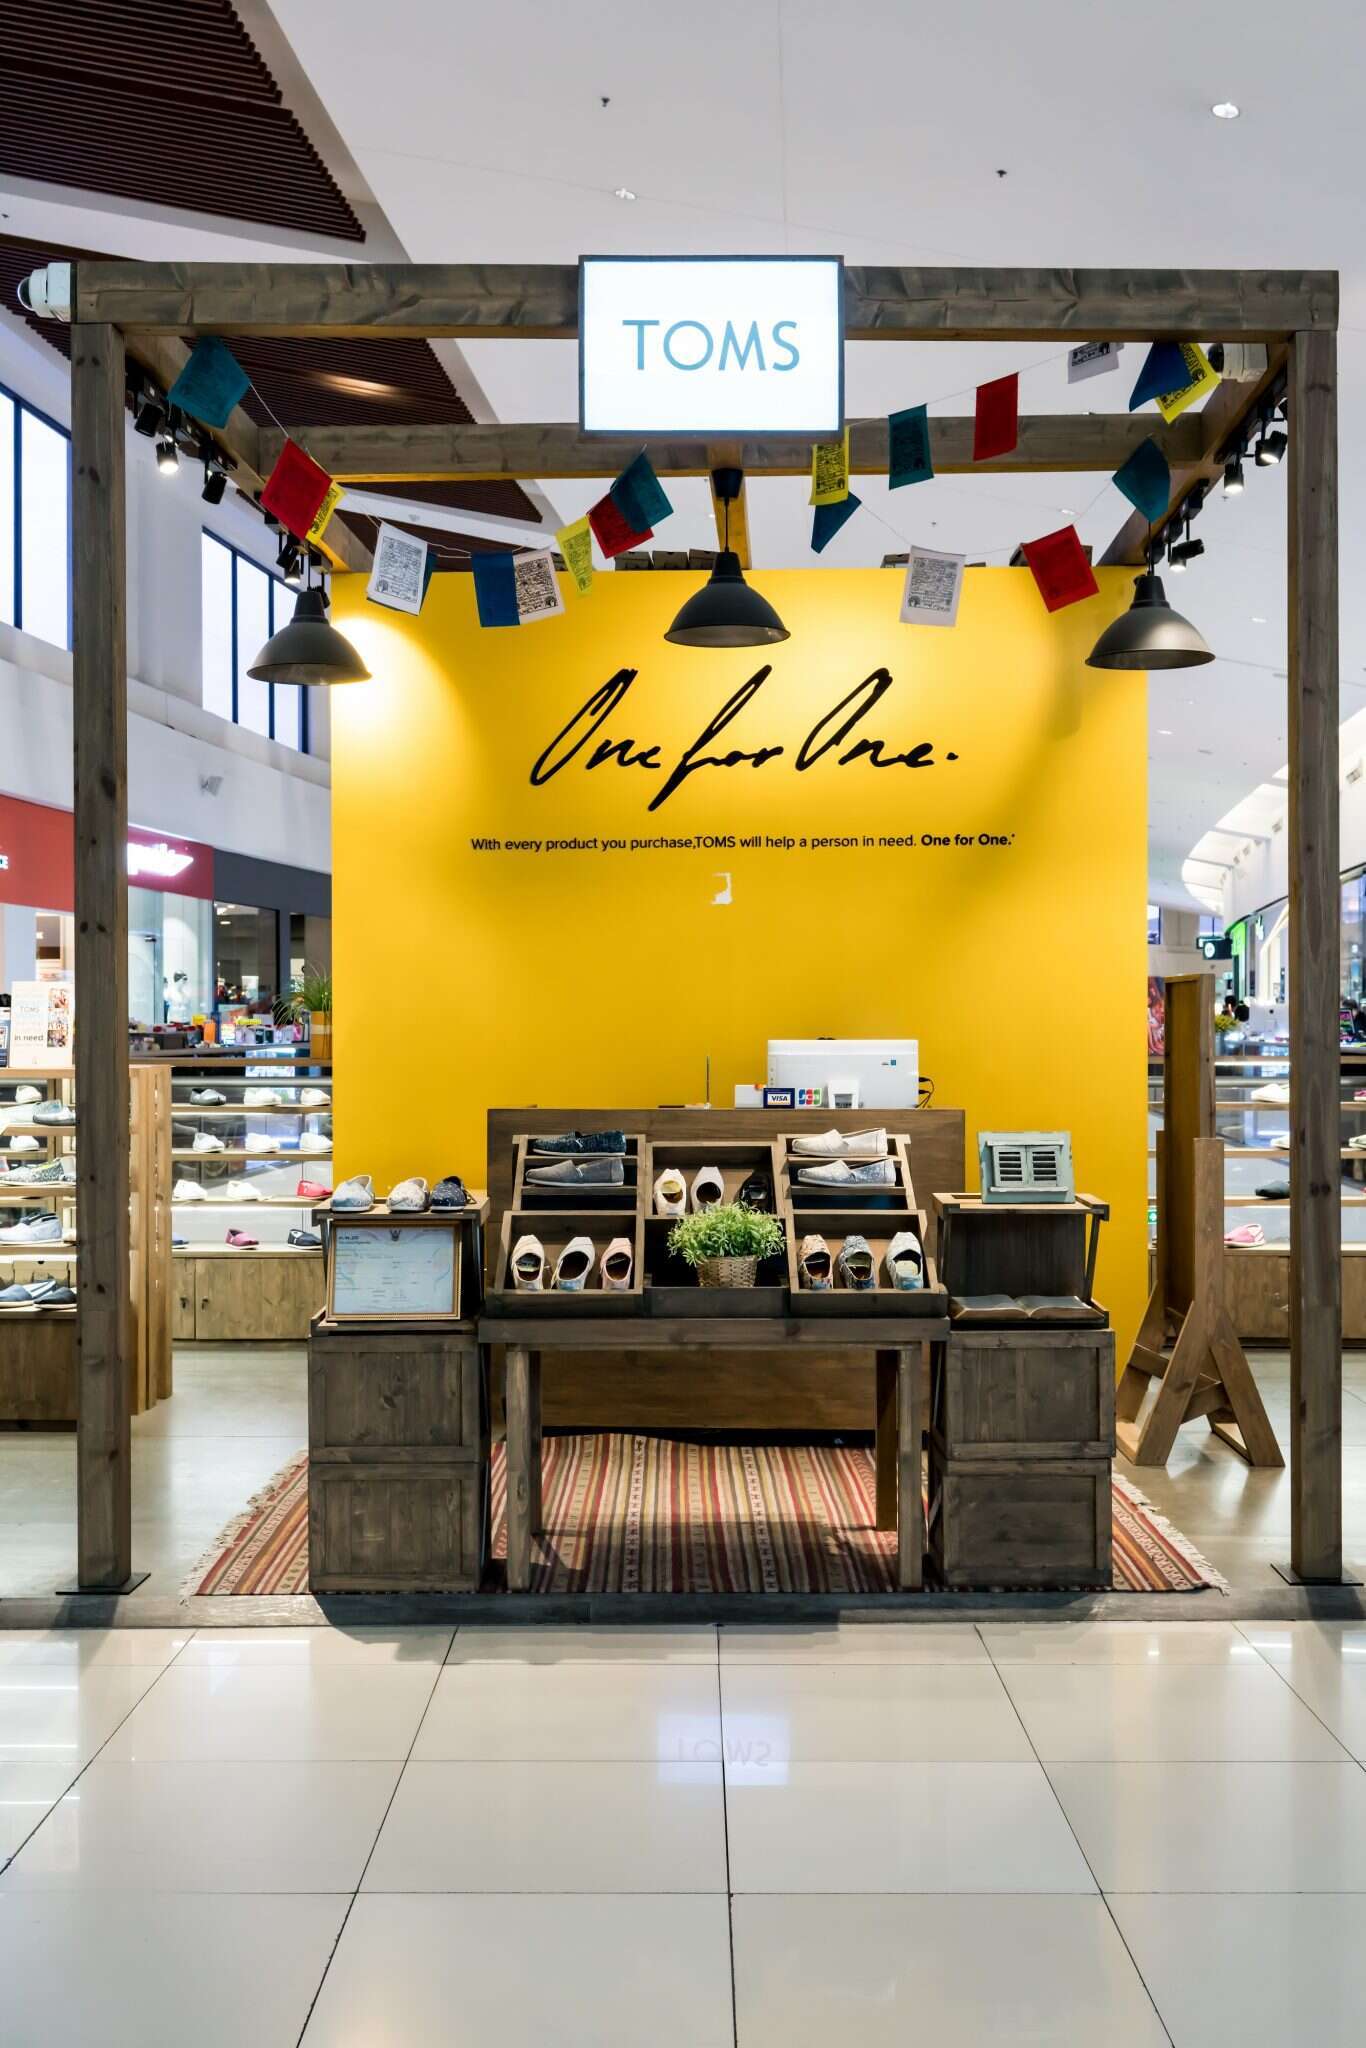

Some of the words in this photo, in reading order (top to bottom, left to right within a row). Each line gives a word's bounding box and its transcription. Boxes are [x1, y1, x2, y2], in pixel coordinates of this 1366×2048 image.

[621, 319, 801, 372] TOMS
[530, 669, 661, 785] One
[648, 665, 784, 811] for
[470, 837, 502, 851] With
[504, 839, 543, 853] every
[545, 837, 599, 853] product
[600, 839, 627, 852] you
[739, 835, 762, 848] will
[765, 835, 796, 851] help
[798, 837, 808, 848] a
[810, 837, 859, 851] person
[862, 834, 875, 847] in
[878, 834, 917, 848] need.
[920, 833, 951, 847] One
[953, 833, 976, 846] for
